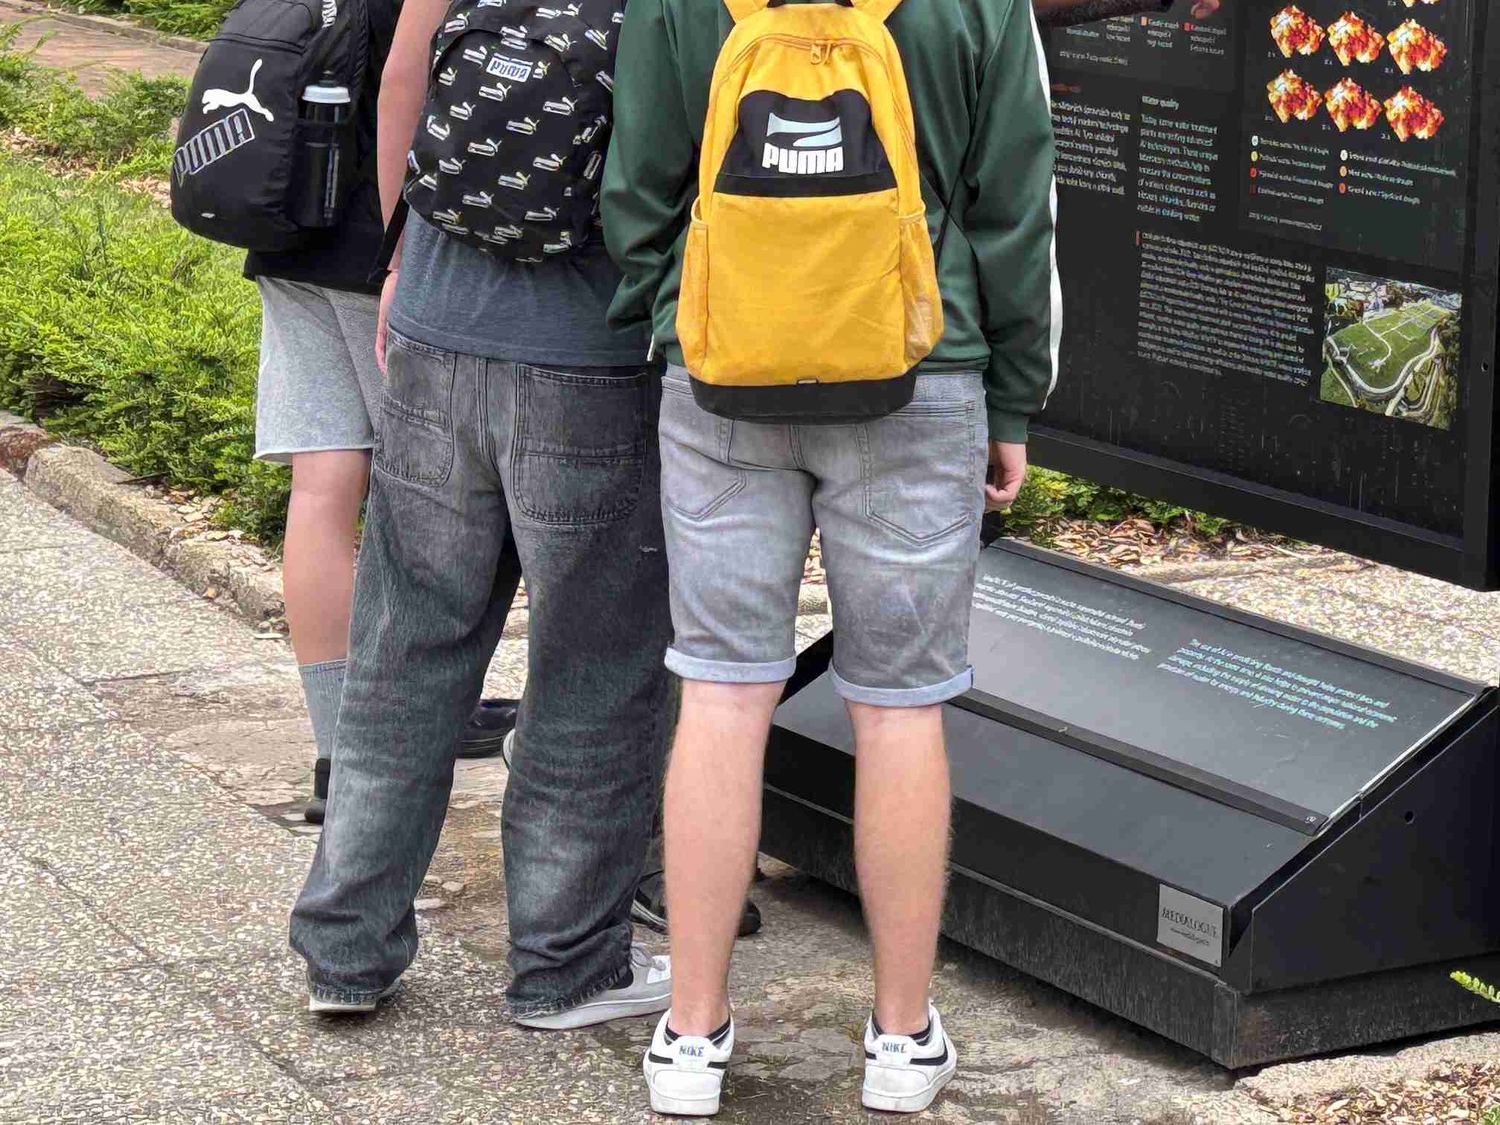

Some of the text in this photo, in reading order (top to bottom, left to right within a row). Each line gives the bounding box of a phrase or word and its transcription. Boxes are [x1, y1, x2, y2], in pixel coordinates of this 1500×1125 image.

[490, 59, 528, 79] PUMA
[174, 108, 255, 187] PUMA
[761, 142, 844, 174] PUMA
[679, 1045, 704, 1057] NIKE
[882, 1042, 907, 1053] NIKE
